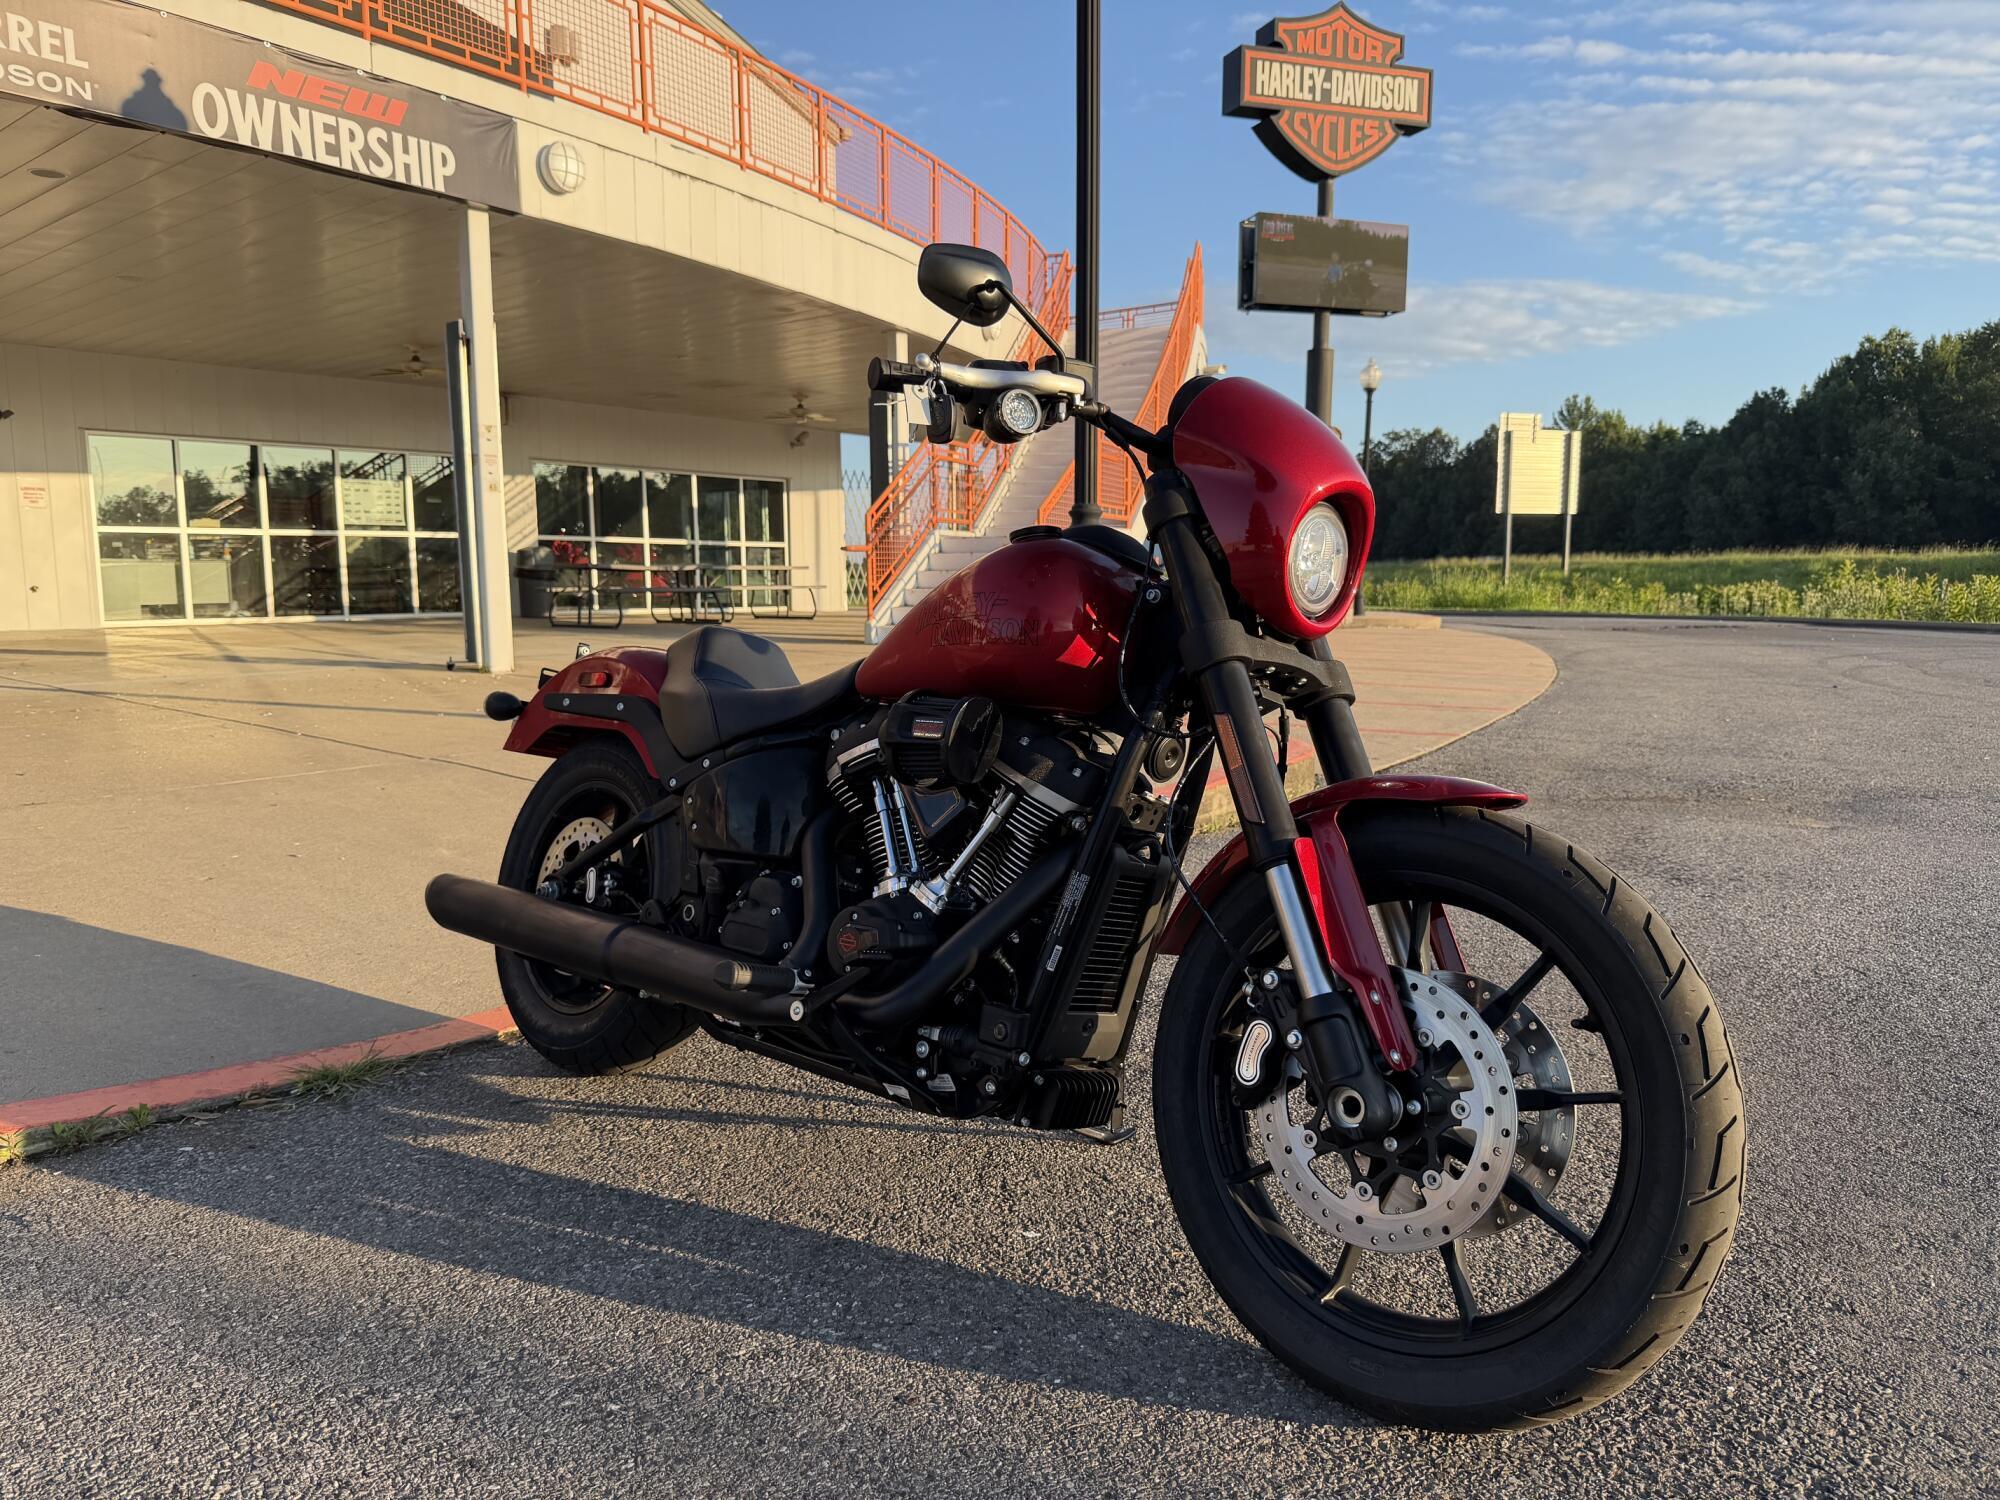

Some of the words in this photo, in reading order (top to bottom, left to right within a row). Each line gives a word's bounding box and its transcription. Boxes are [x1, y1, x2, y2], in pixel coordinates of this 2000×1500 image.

[1297, 21, 1383, 63] MOTOR
[246, 60, 408, 124] NEW
[1255, 59, 1419, 113] HARLEY-DAVIDSON
[192, 82, 456, 192] OWNERSHIP
[1294, 114, 1381, 160] CYCLES
